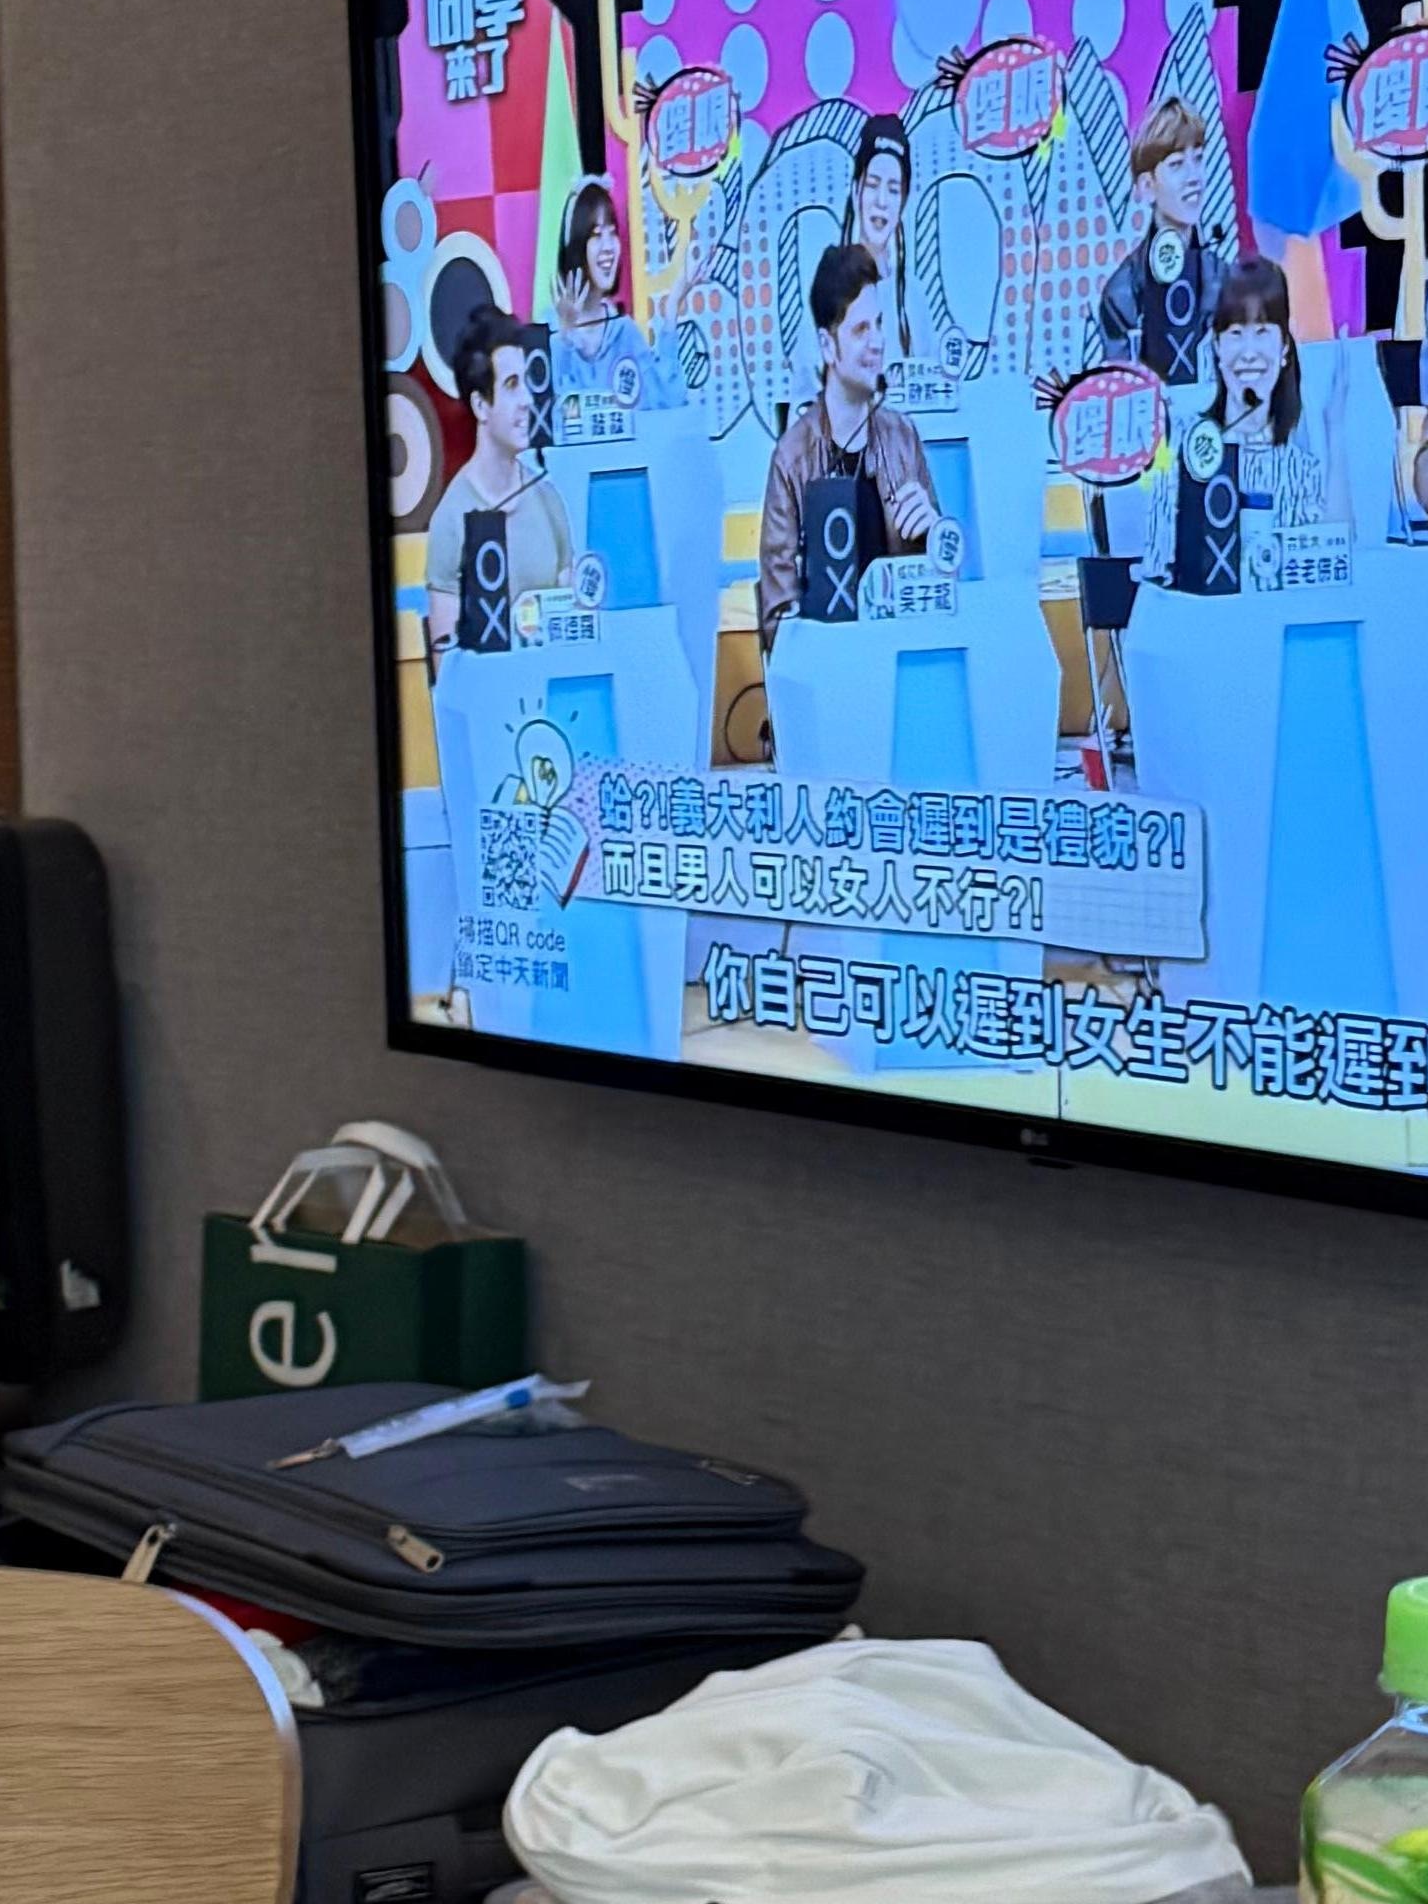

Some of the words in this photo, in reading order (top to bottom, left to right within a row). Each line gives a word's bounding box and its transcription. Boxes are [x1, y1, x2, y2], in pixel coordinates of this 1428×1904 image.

[445, 39, 509, 102] 來了
[601, 839, 1045, 932] 而且男人可以女人不行?!
